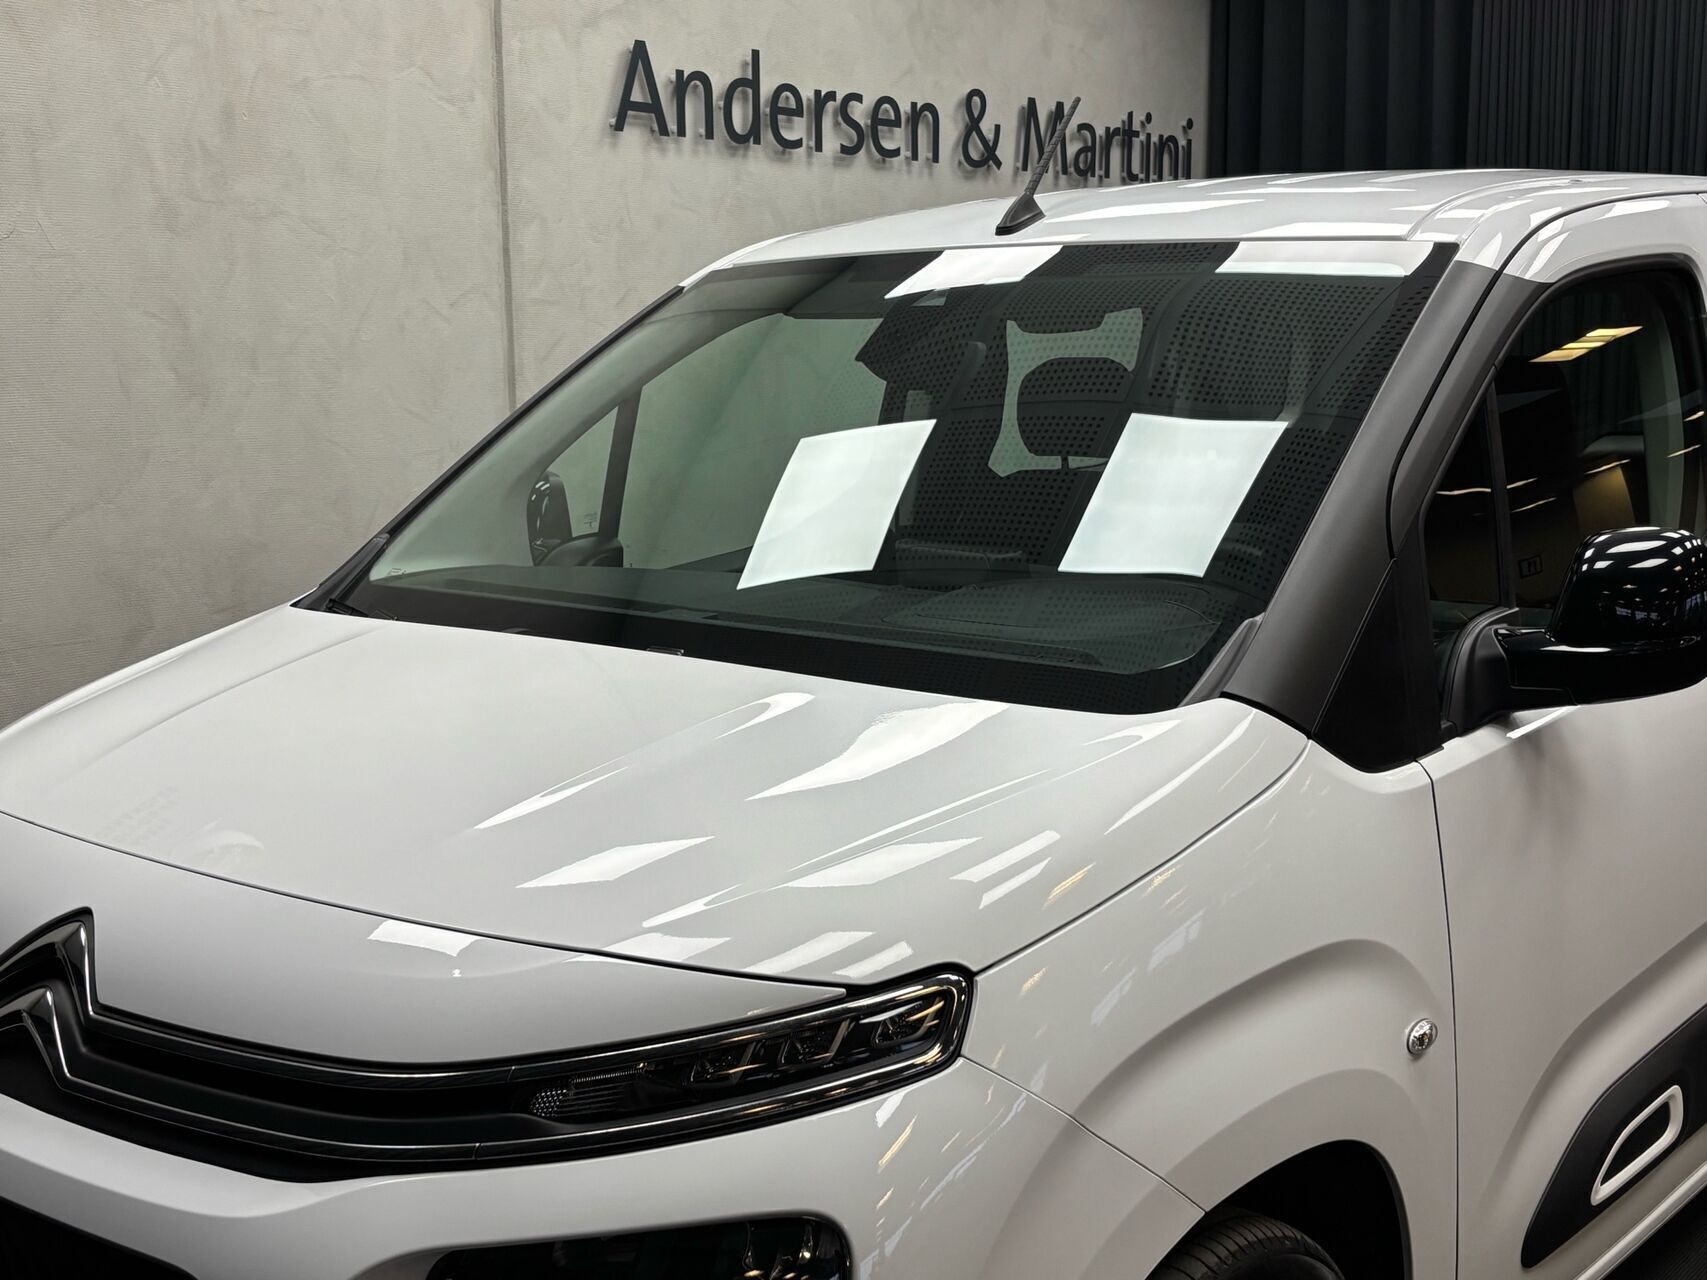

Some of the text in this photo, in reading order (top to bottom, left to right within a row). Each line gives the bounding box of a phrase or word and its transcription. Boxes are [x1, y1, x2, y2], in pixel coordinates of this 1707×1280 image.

[613, 39, 1194, 182] Andersen & Martini
